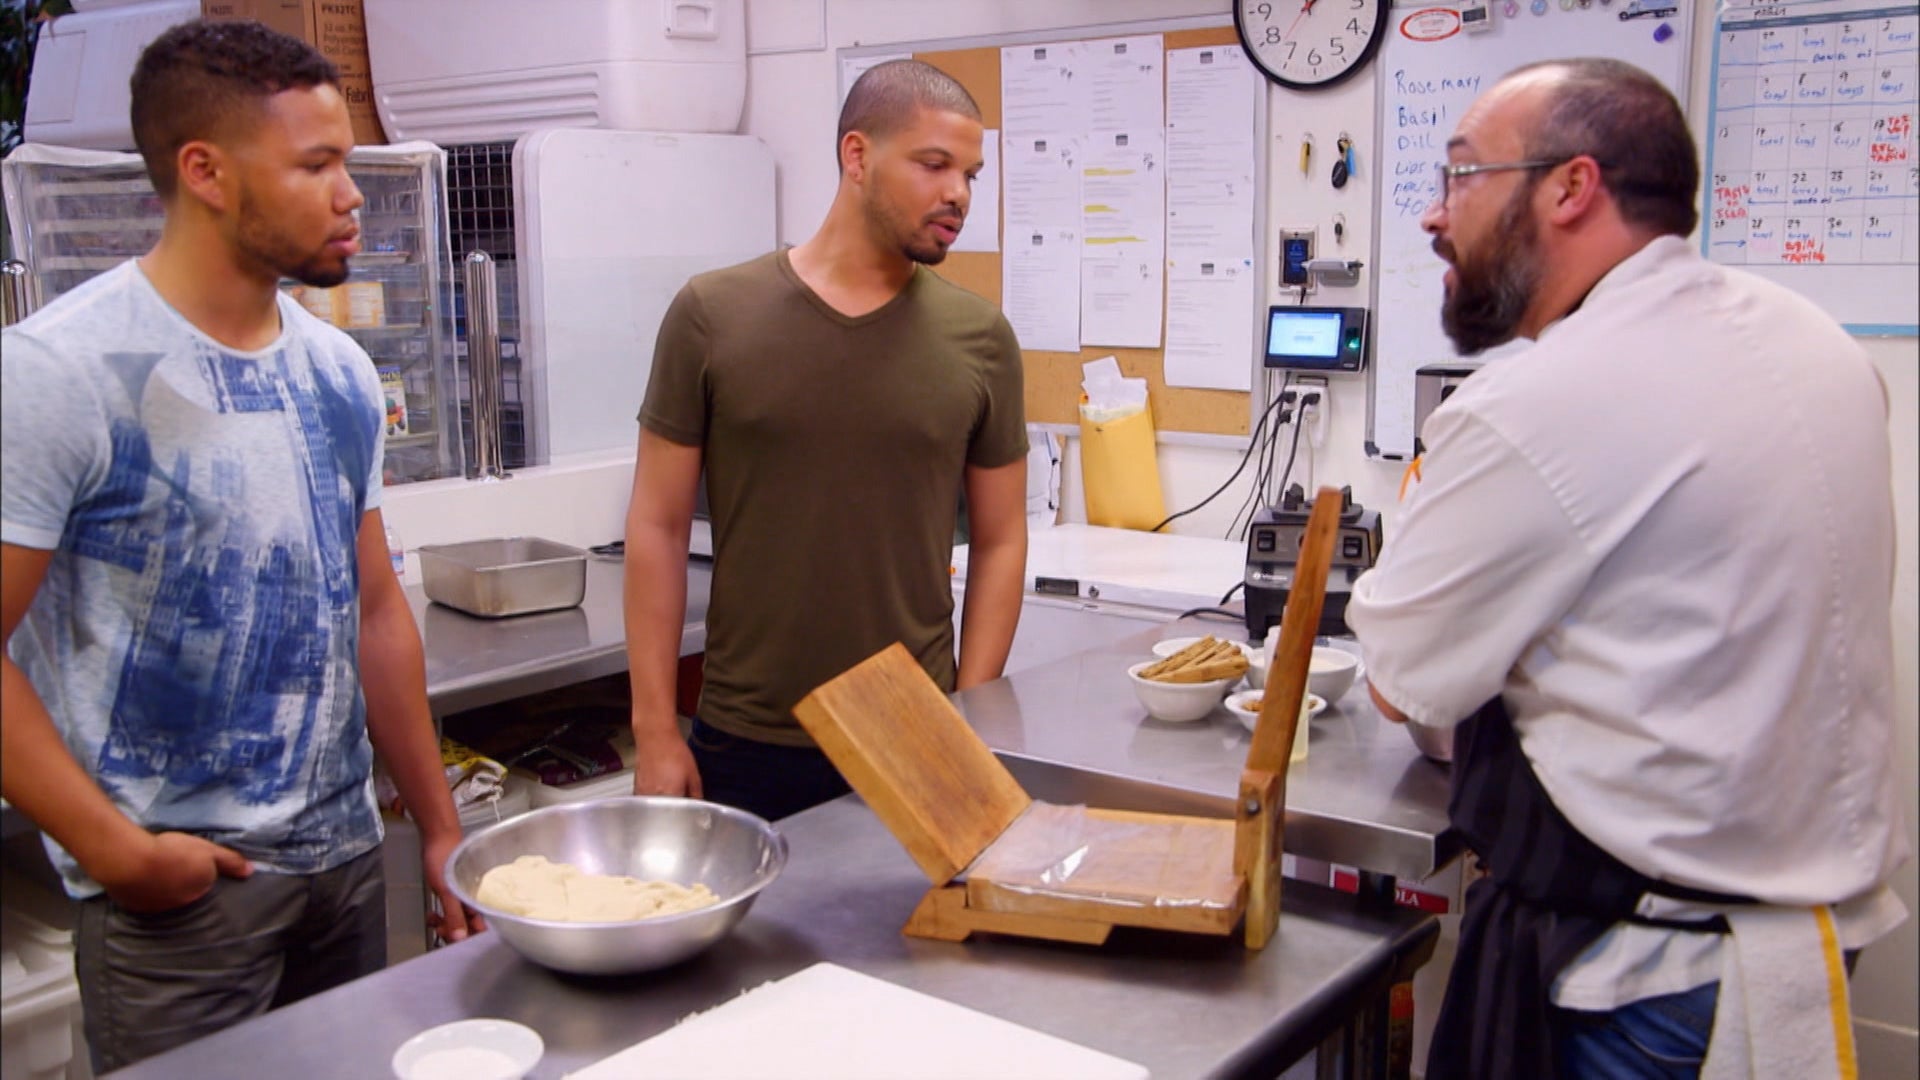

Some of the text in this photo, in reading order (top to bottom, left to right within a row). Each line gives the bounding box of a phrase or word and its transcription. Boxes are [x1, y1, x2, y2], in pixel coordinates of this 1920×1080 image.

[1257, 3, 1272, 21] 9
[1265, 26, 1281, 44] 8
[1345, 17, 1359, 35] 4
[1284, 41, 1297, 60] 7
[1330, 37, 1344, 55] 5
[1307, 48, 1322, 66] 6
[1399, 105, 1446, 127] Basil
[1398, 132, 1435, 150] Dill
